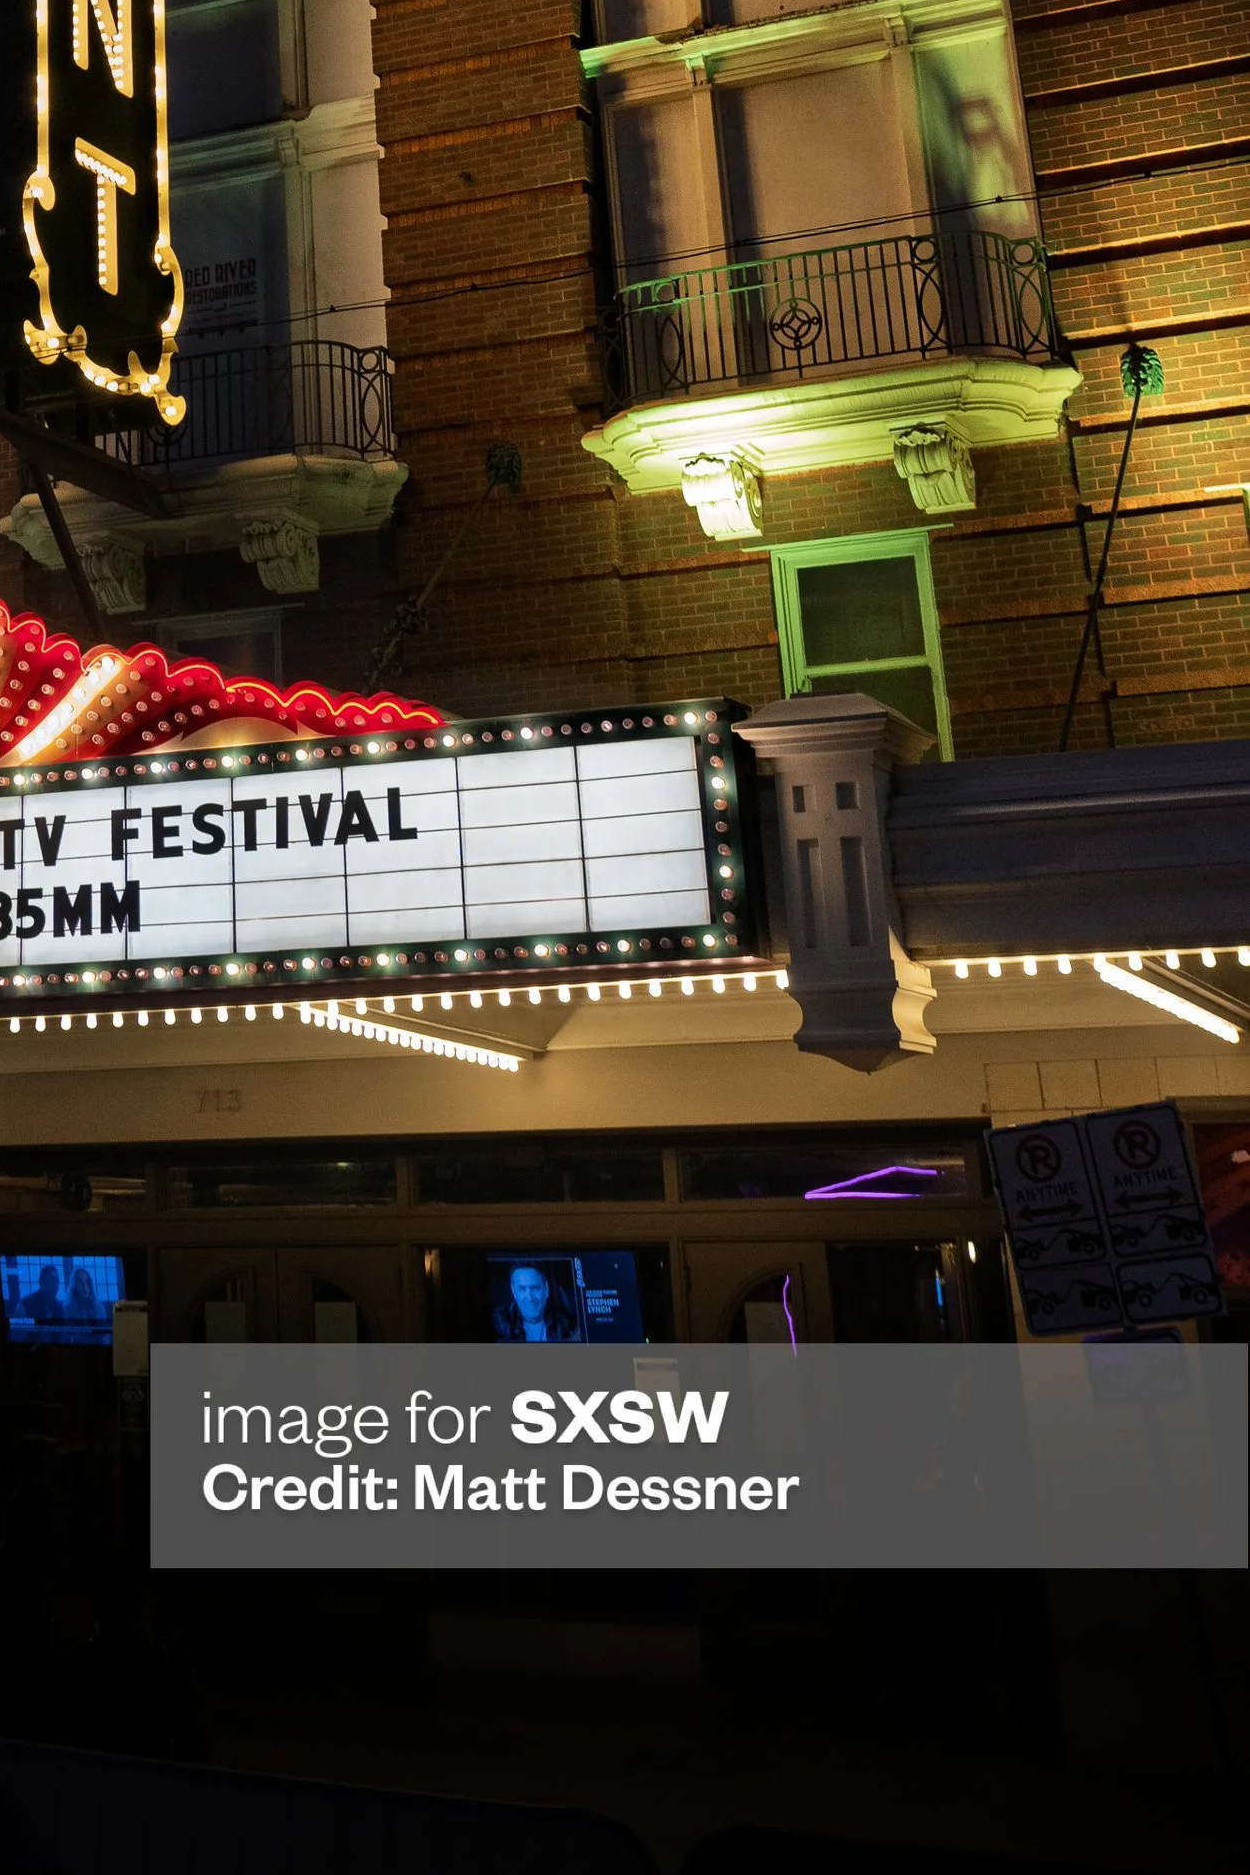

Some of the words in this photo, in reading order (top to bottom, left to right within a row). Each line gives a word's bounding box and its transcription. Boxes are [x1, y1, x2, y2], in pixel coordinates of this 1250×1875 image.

[215, 258, 257, 283] RIVER
[111, 786, 418, 861] FESTIVAL
[196, 1089, 240, 1113] 713
[1113, 1166, 1178, 1188] ANYTIME
[1015, 1181, 1079, 1203] ANYTIME
